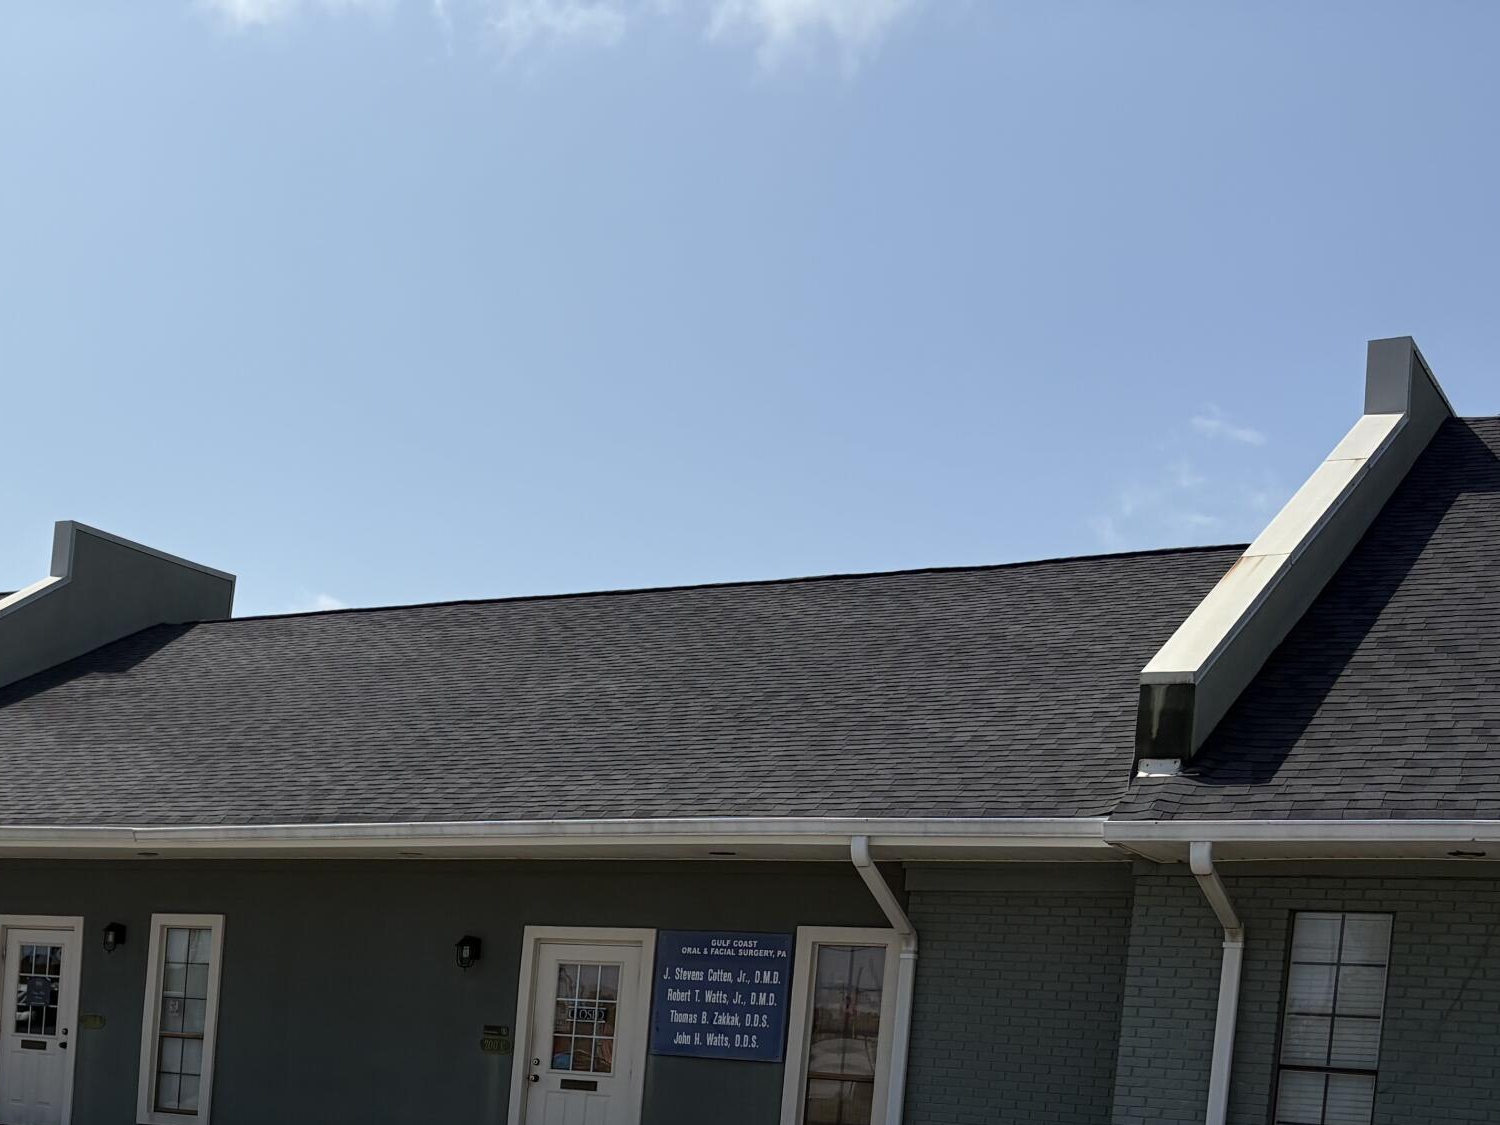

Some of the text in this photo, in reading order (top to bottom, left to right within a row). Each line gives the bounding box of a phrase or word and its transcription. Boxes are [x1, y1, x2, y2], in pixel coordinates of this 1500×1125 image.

[711, 939, 758, 948] GULF COAST
[681, 947, 787, 958] ORAL & FACIAL SURGERY, PA
[663, 967, 671, 980] J.
[675, 968, 704, 981] Stevens
[708, 969, 734, 983] Cotten,
[755, 971, 781, 985] D.M.D.
[667, 988, 691, 1002] Robert
[695, 990, 701, 1003] T.
[705, 990, 729, 1005] Watts,
[750, 992, 777, 1006] D.M.D.
[670, 1010, 770, 1028] Thomas B. Zakkak, D.D.S.
[673, 1032, 759, 1048] John H. Watts, D.D.S.
